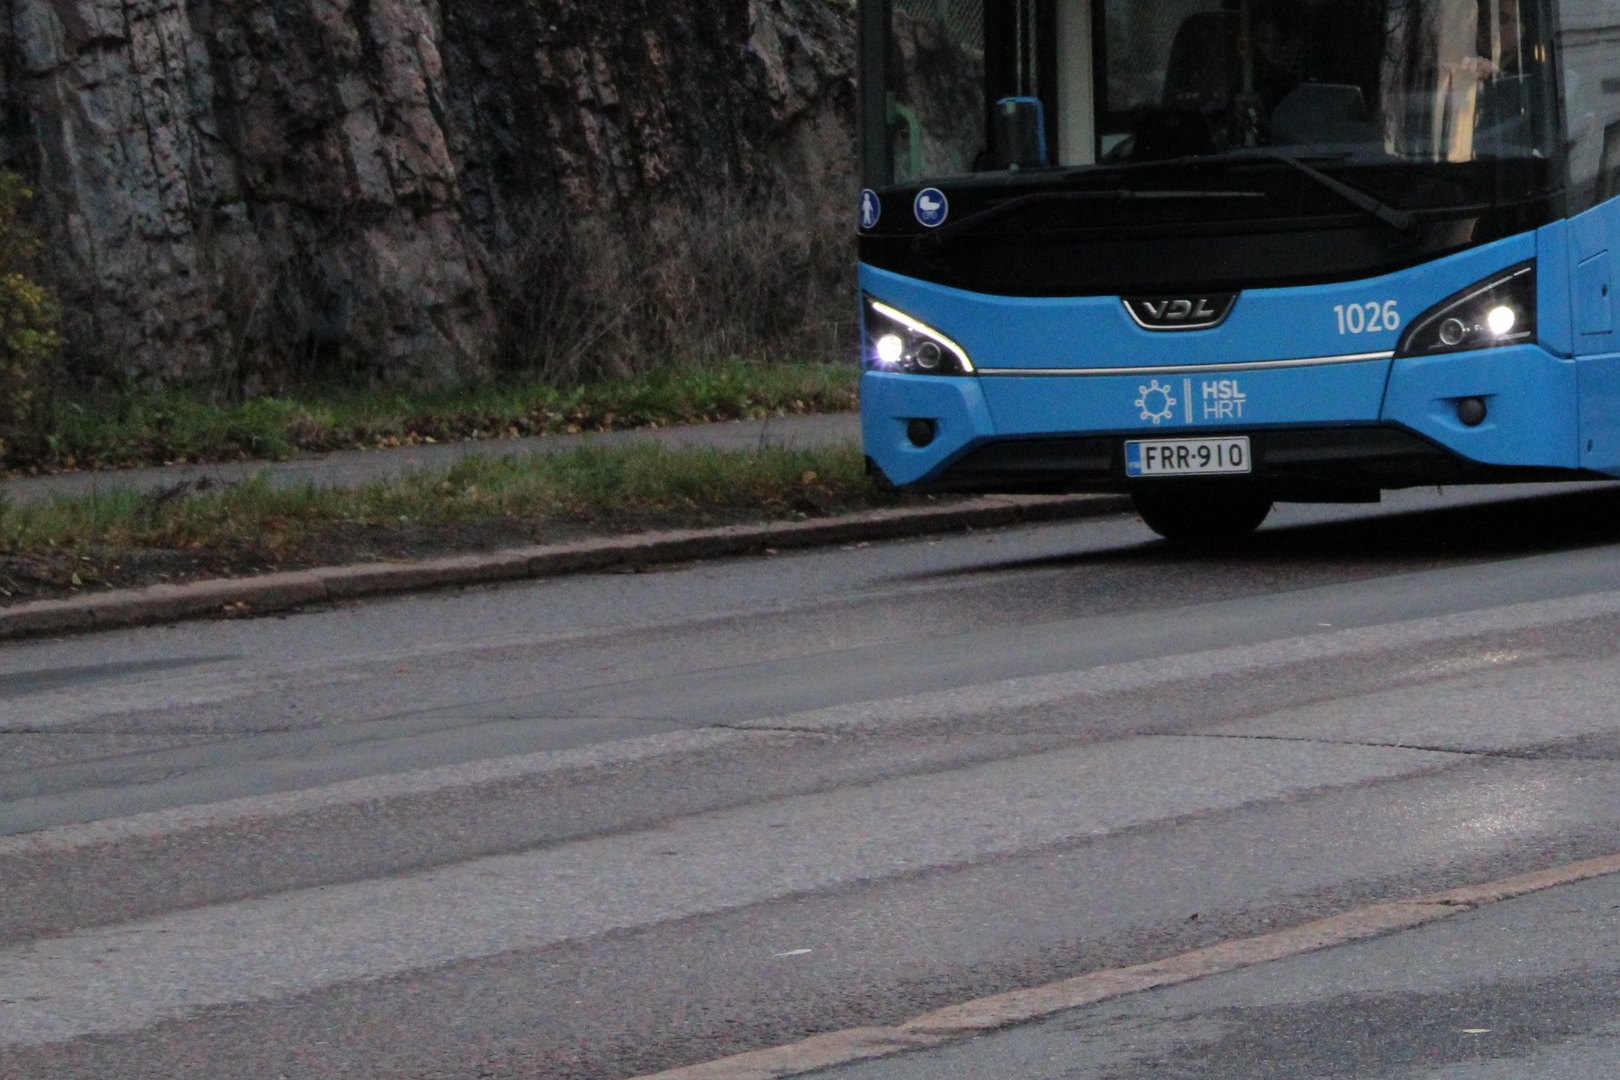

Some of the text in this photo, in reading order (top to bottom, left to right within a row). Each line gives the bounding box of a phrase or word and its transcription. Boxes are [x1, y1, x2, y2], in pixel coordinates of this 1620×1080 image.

[1143, 299, 1215, 319] VDL
[1333, 300, 1400, 335] 1026
[1202, 380, 1246, 400] HSL
[1203, 399, 1246, 419] HRT
[1145, 443, 1243, 469] FRR-910
